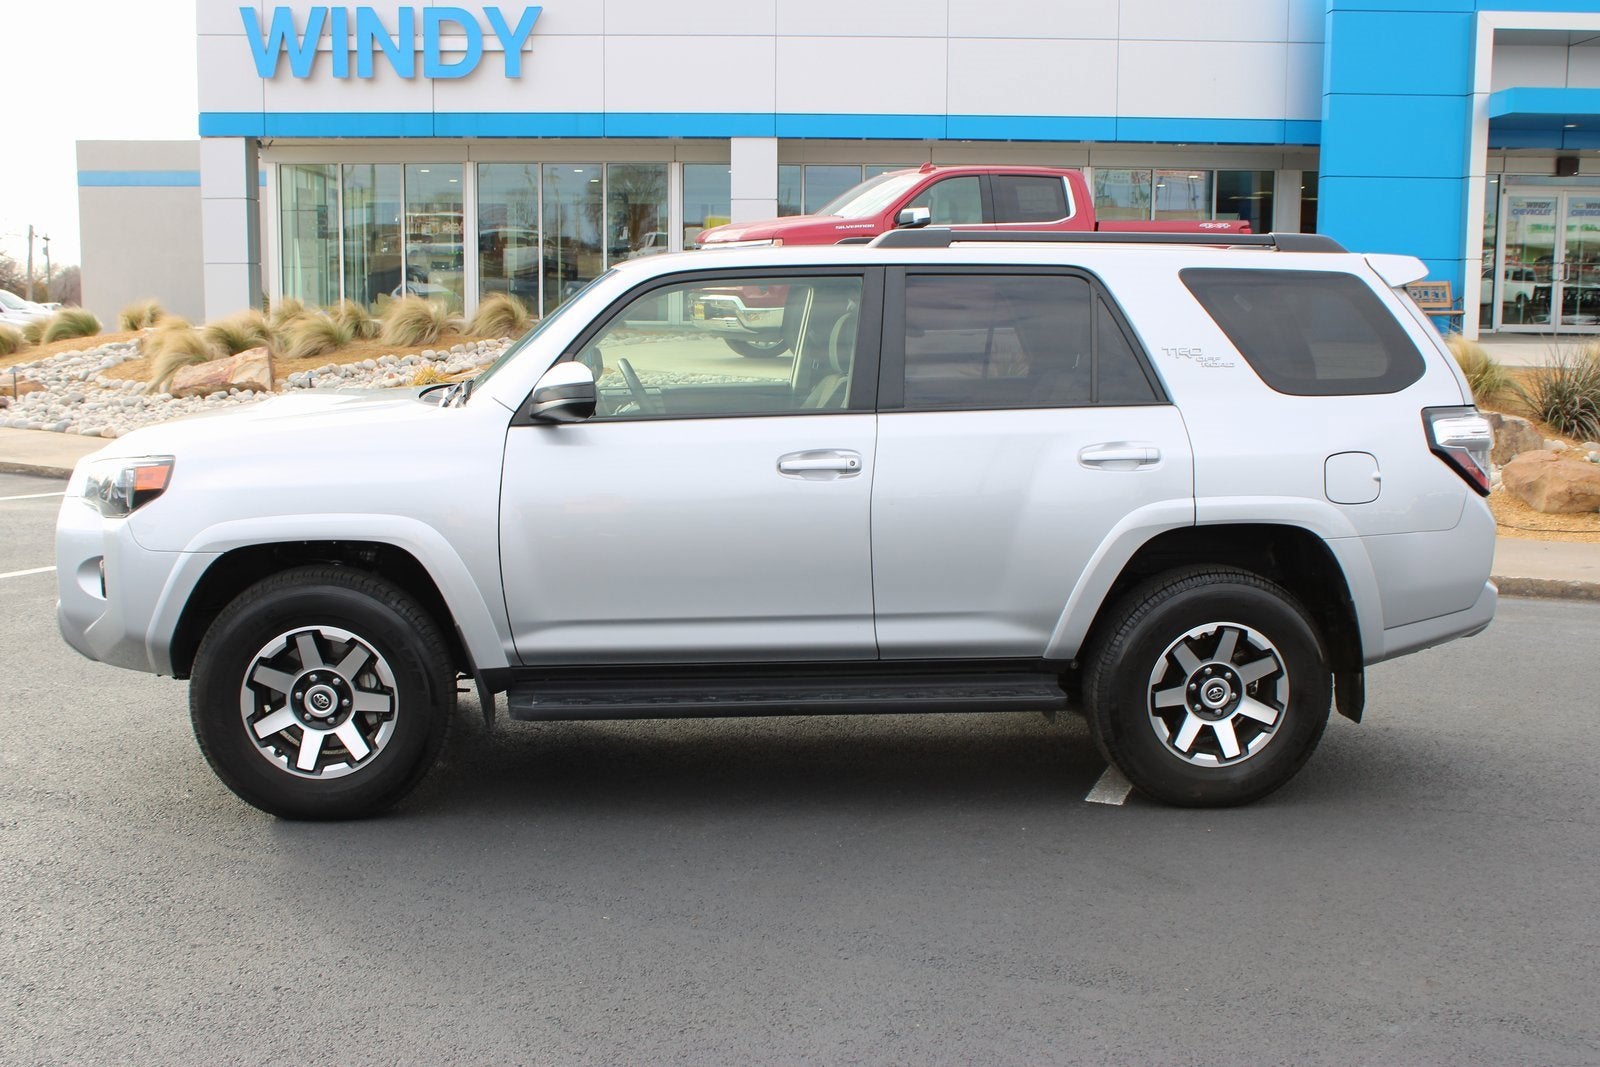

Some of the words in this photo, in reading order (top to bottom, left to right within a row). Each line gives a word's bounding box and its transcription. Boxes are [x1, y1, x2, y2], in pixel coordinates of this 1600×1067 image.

[239, 6, 543, 79] WINDY
[1526, 201, 1551, 209] WINDY
[1585, 202, 1600, 210] WIN
[1512, 208, 1553, 216] CHEVROLET
[1571, 209, 1600, 217] CHEVRO
[1161, 346, 1202, 359] TRD
